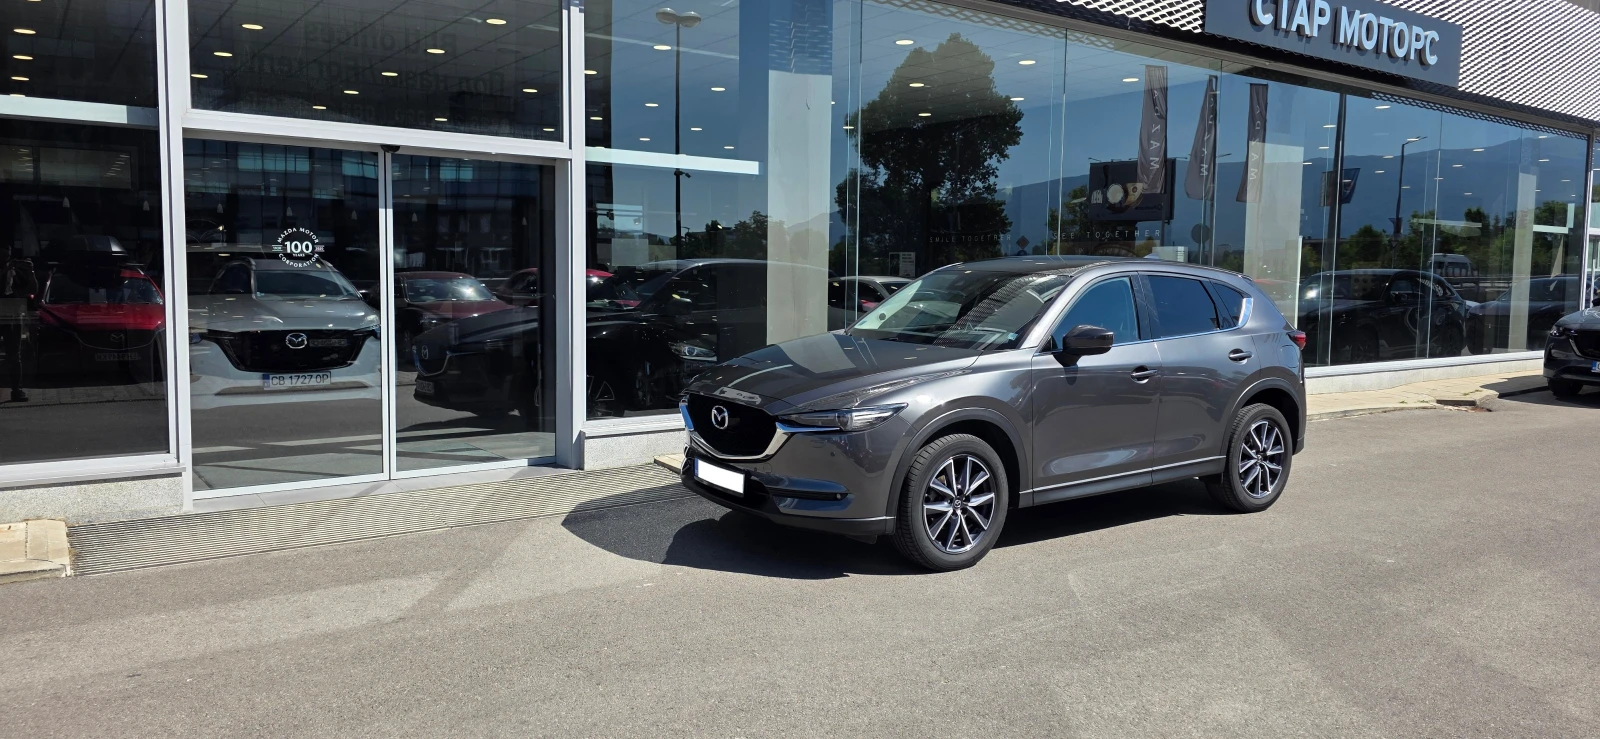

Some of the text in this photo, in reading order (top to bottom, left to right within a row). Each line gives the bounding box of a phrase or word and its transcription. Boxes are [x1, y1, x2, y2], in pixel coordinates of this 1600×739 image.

[1339, 5, 1440, 65] МОТОРС
[277, 227, 319, 243] MAZDA MOTOR
[929, 234, 1011, 243] SMILE TOGETHER
[1053, 229, 1160, 240] SEE TOGETHER
[284, 241, 312, 253] 100
[278, 253, 319, 268] CORPORATION
[271, 375, 285, 386] CB
[288, 374, 313, 385] 1727
